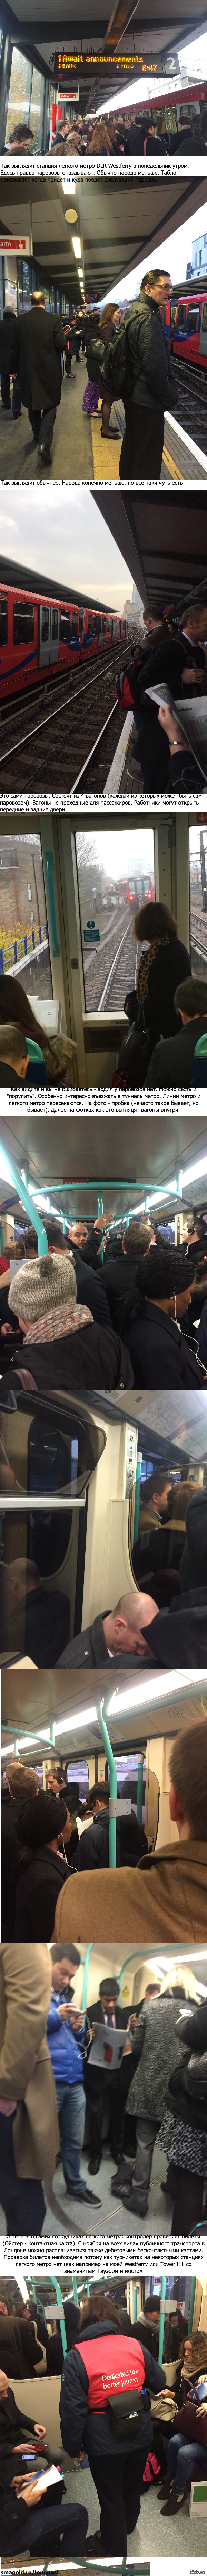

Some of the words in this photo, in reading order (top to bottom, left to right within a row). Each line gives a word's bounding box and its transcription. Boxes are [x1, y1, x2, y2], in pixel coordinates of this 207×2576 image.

[167, 57, 176, 70] 2
[102, 2370, 129, 2381] Dedicated
[121, 2377, 139, 2387] journey
